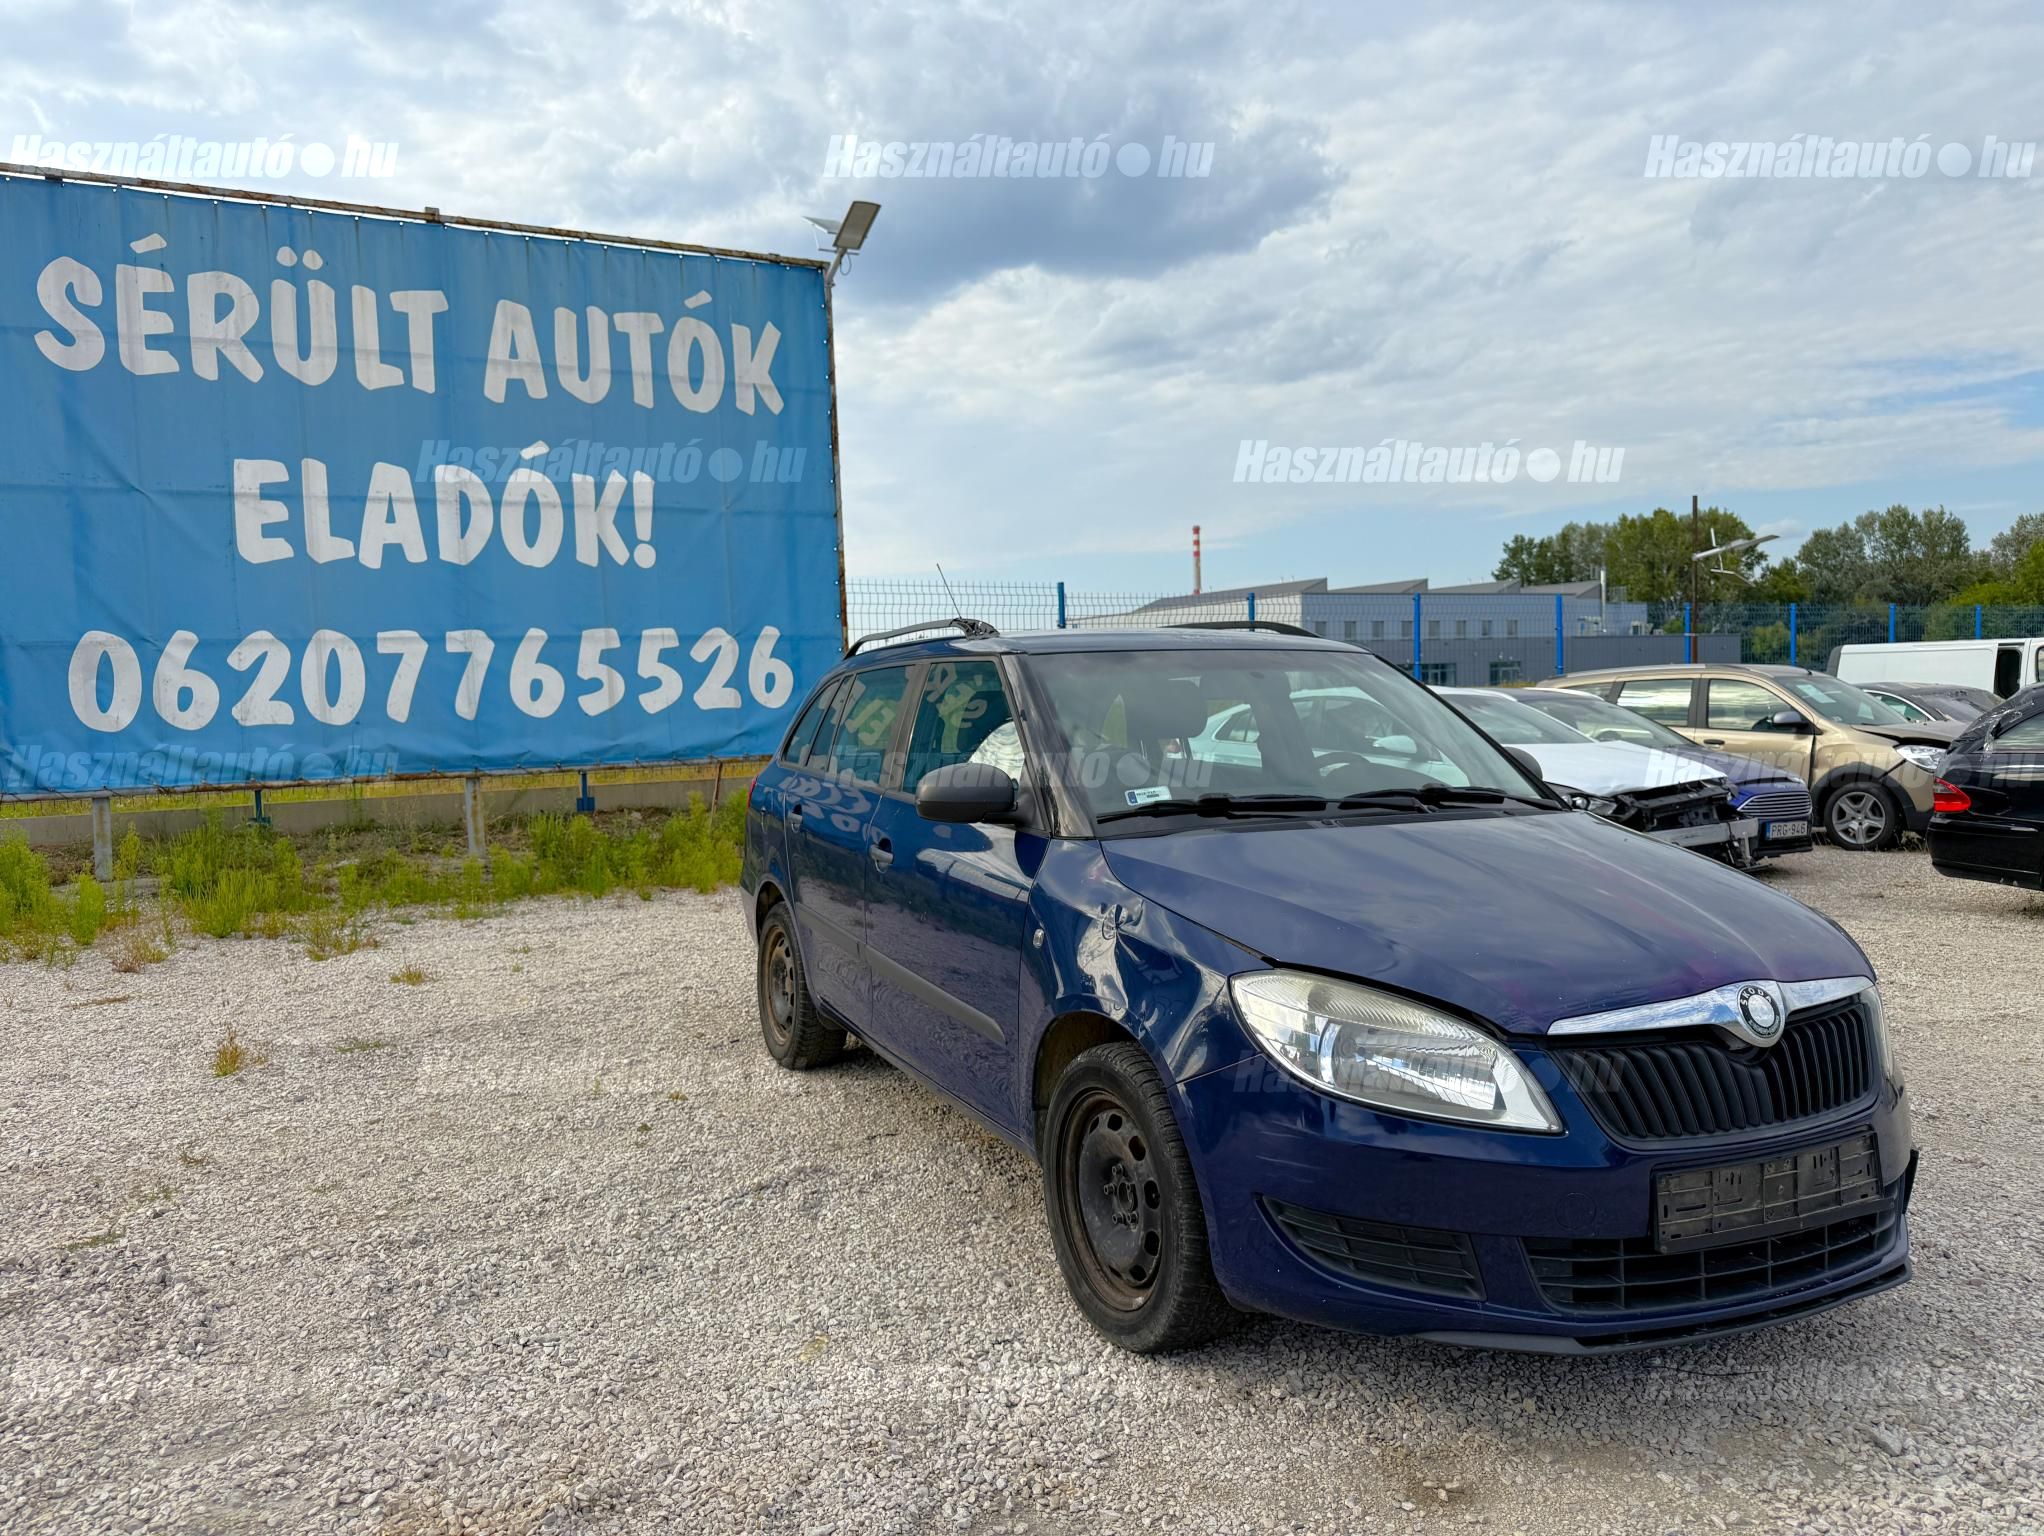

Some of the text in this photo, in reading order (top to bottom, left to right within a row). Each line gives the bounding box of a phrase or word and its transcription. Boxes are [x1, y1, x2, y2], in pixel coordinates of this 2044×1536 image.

[33, 232, 786, 416] SÉRÜLT AUTÓK
[233, 441, 656, 570] ELADÓK!
[68, 625, 795, 734] 06207765526
